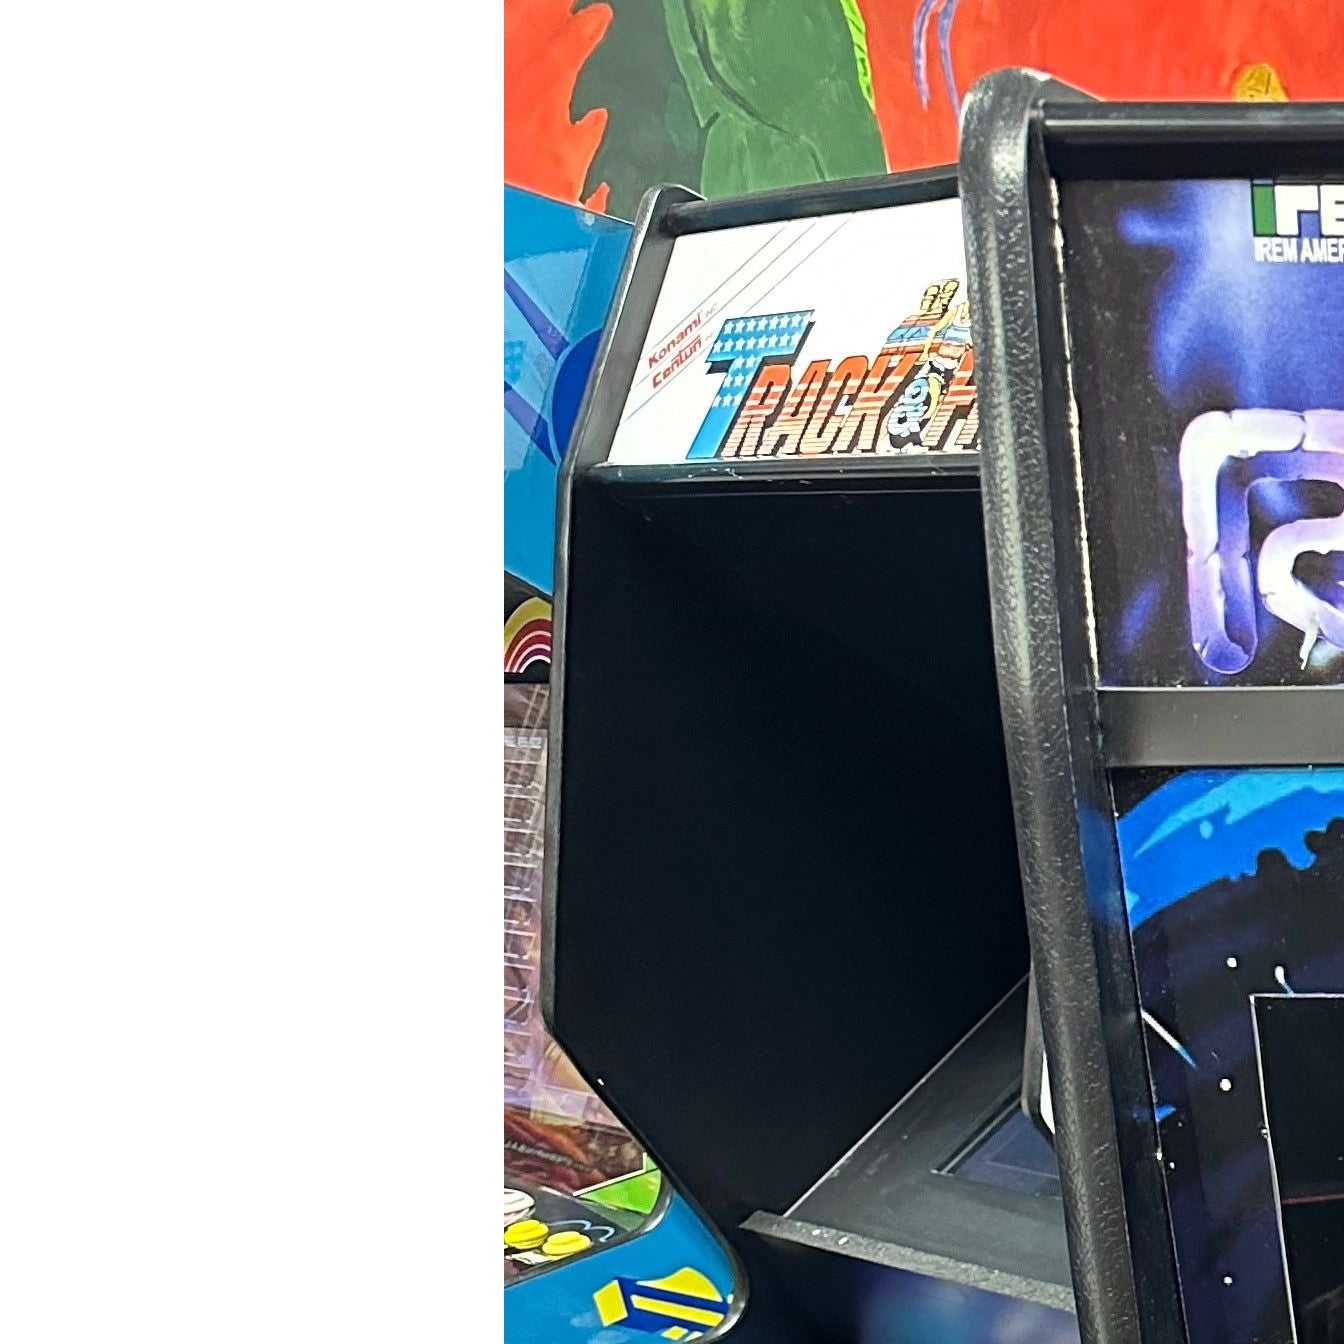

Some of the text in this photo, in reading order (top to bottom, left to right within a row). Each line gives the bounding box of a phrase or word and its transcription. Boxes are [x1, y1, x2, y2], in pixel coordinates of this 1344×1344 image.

[1253, 237, 1298, 264] IREM
[648, 311, 703, 370] Konami
[685, 309, 924, 460] TRACK
